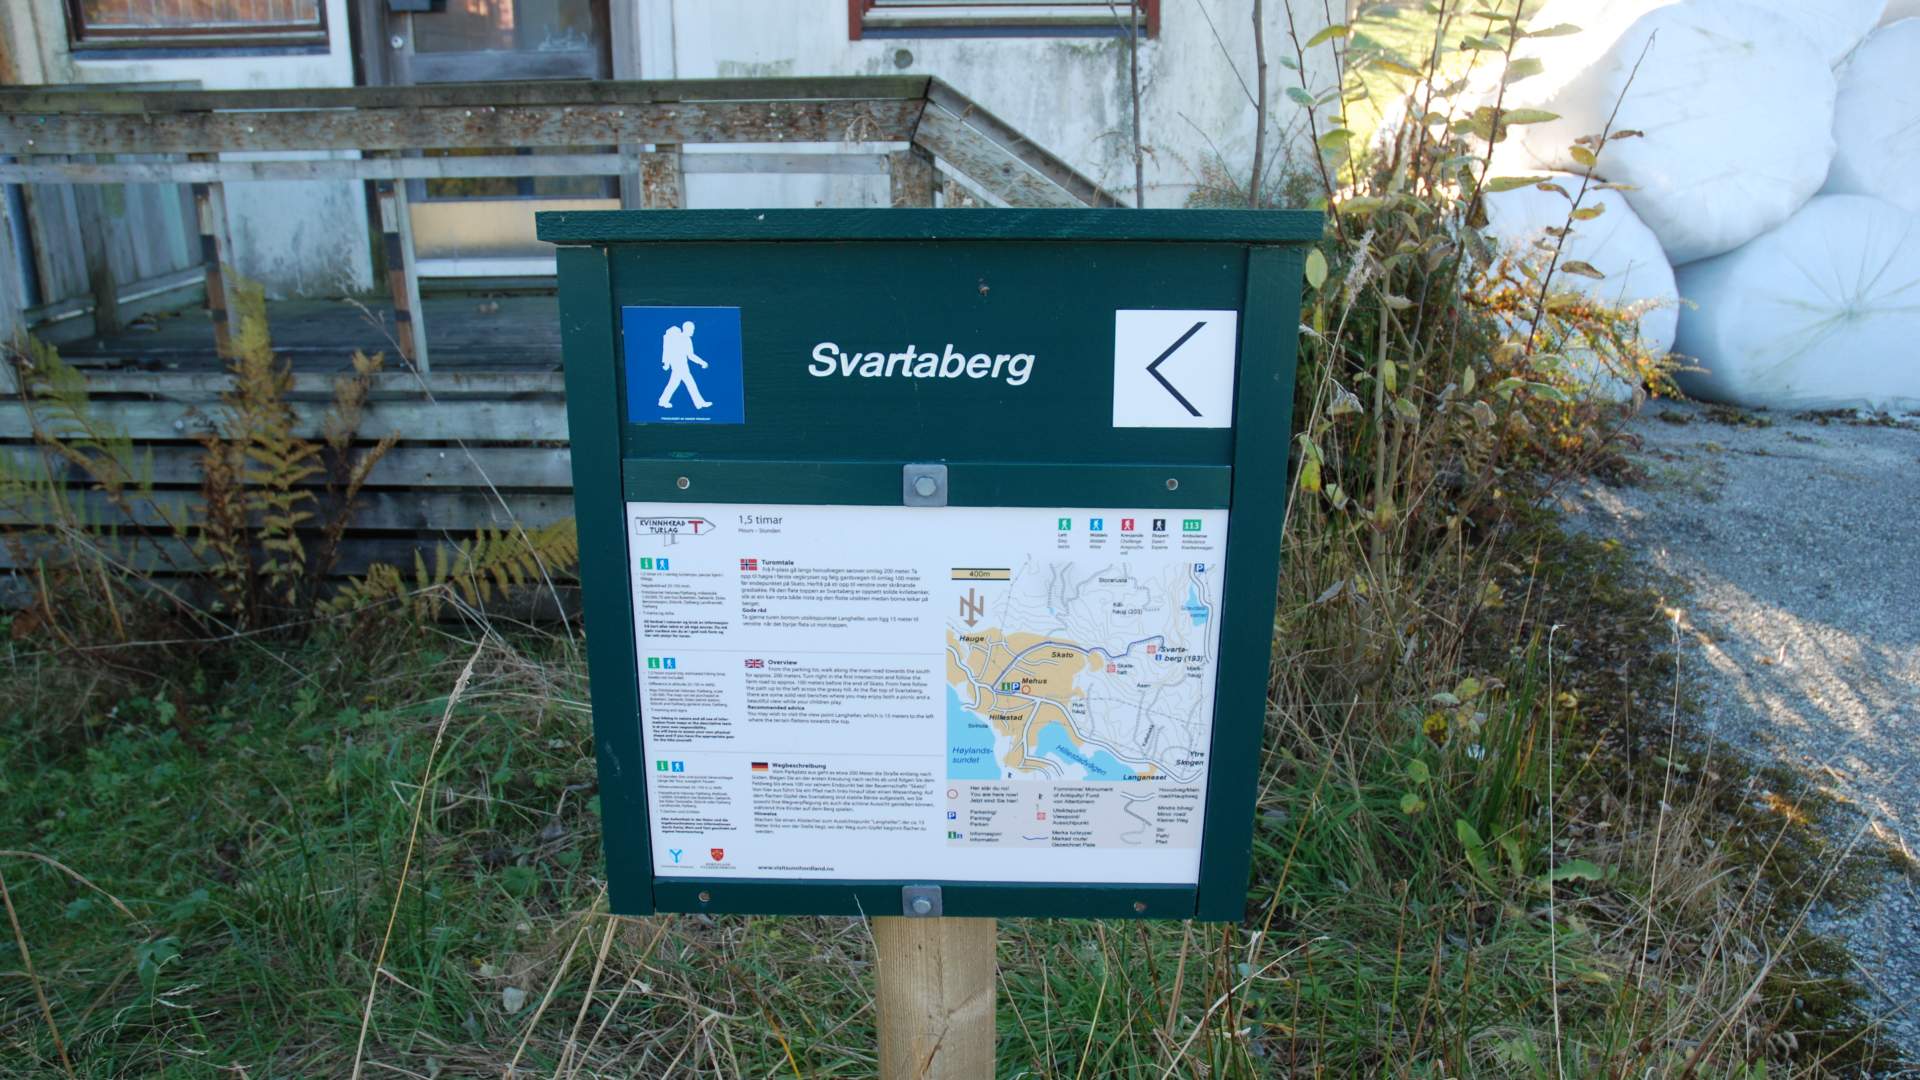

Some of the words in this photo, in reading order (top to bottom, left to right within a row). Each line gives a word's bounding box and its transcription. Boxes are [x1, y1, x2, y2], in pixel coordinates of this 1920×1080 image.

[808, 342, 1036, 386] Svartaberg
[738, 515, 753, 525] 1,5
[756, 514, 782, 524] timar
[960, 635, 984, 643] Hauge
[952, 746, 993, 755] Høylands-
